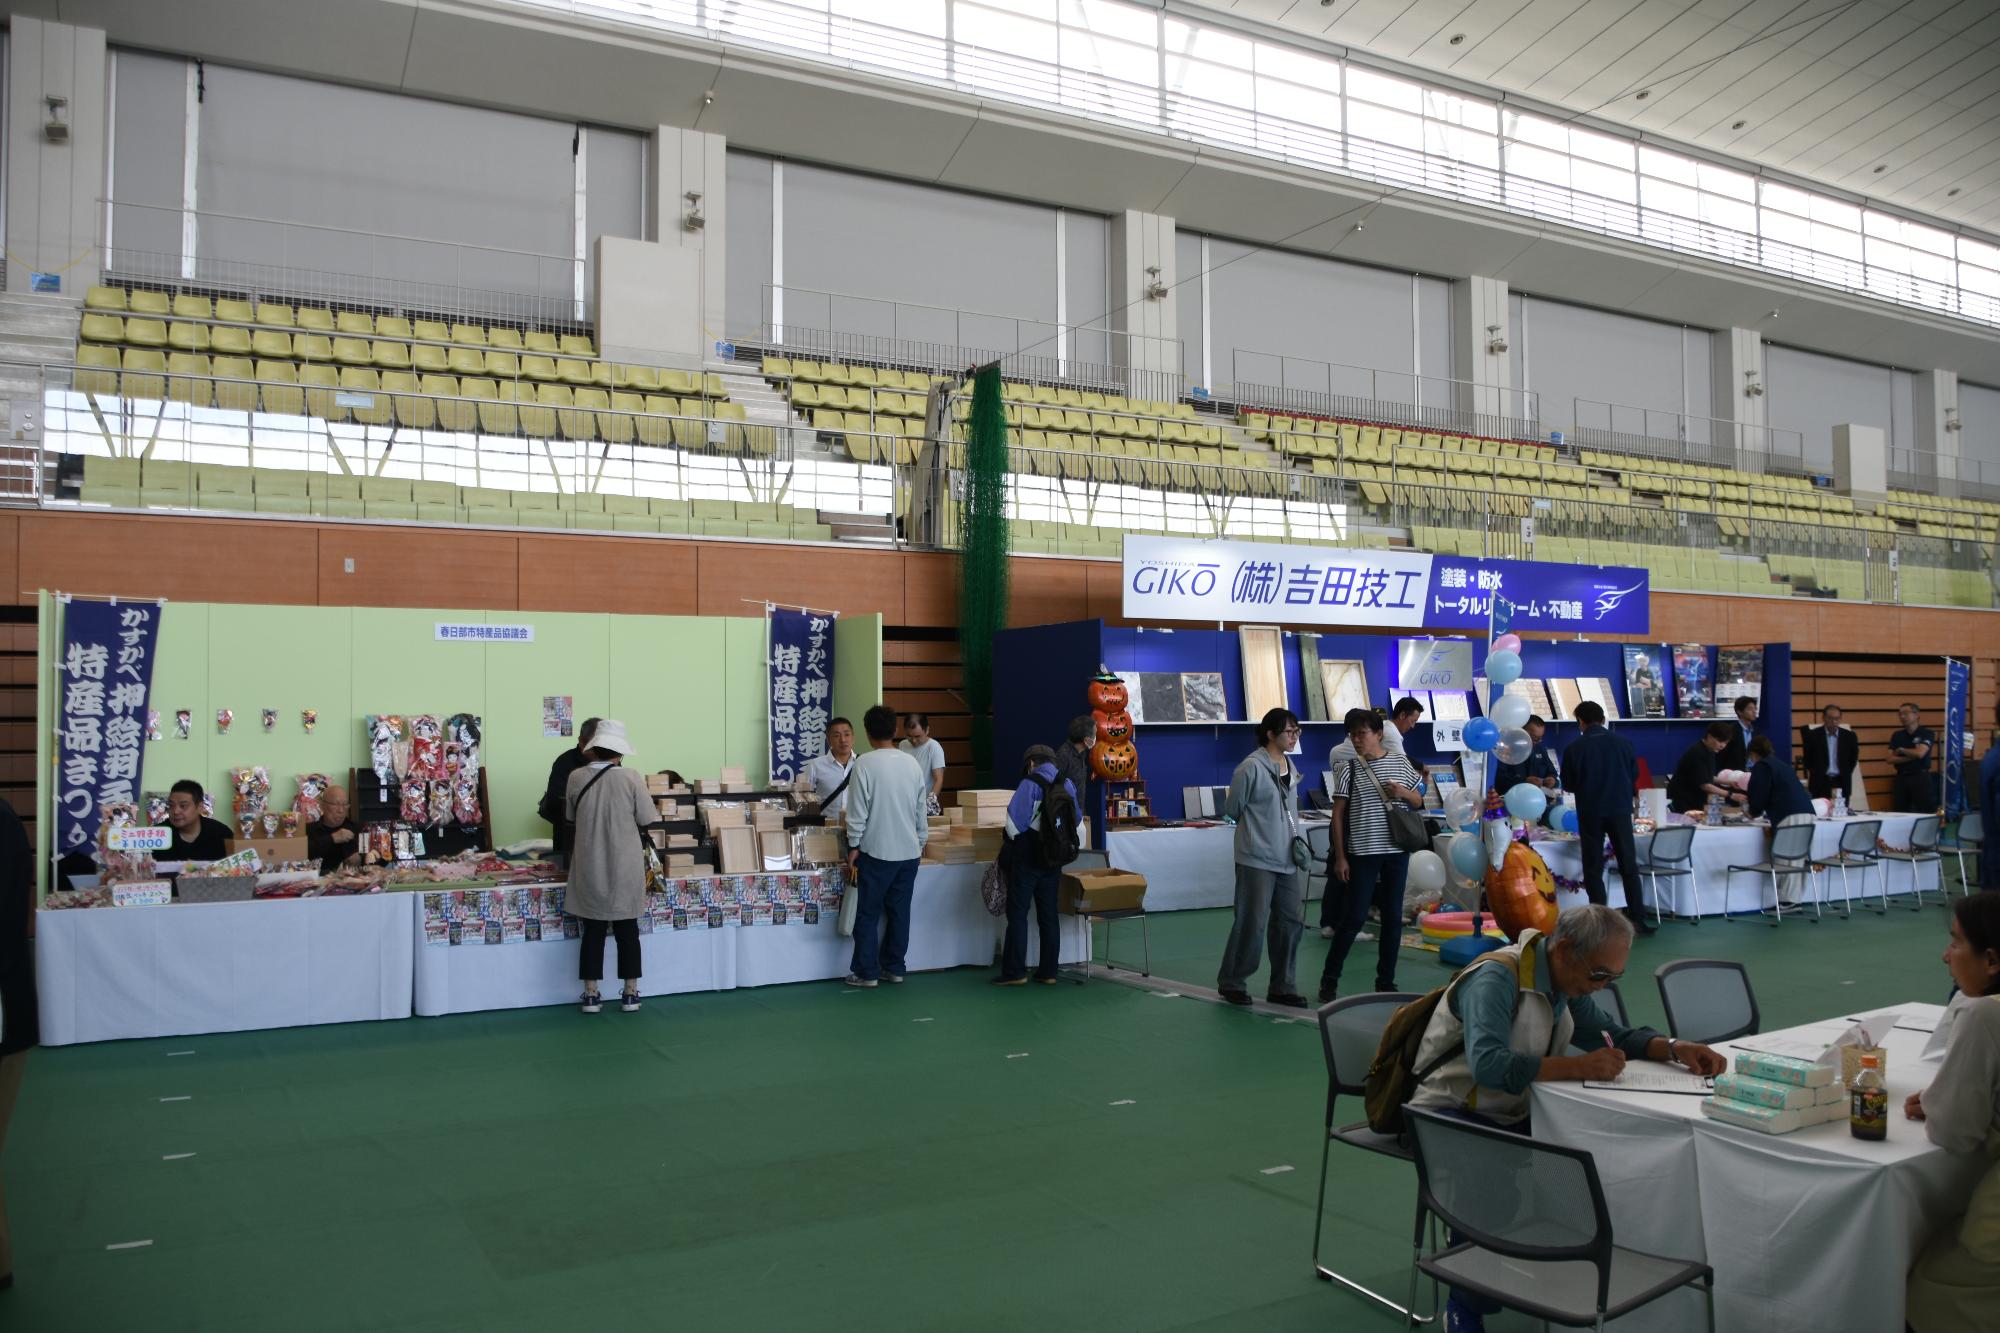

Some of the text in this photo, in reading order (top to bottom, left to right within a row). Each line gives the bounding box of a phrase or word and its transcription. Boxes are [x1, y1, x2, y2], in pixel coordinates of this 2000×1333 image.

[1140, 559, 1196, 567] YOSHIDA
[1231, 560, 1422, 609] (株)吉田技工
[1441, 567, 1502, 590] 塗装・防水
[440, 626, 528, 639] 春日部市特産品協議会
[64, 642, 109, 848] 特産品まつり
